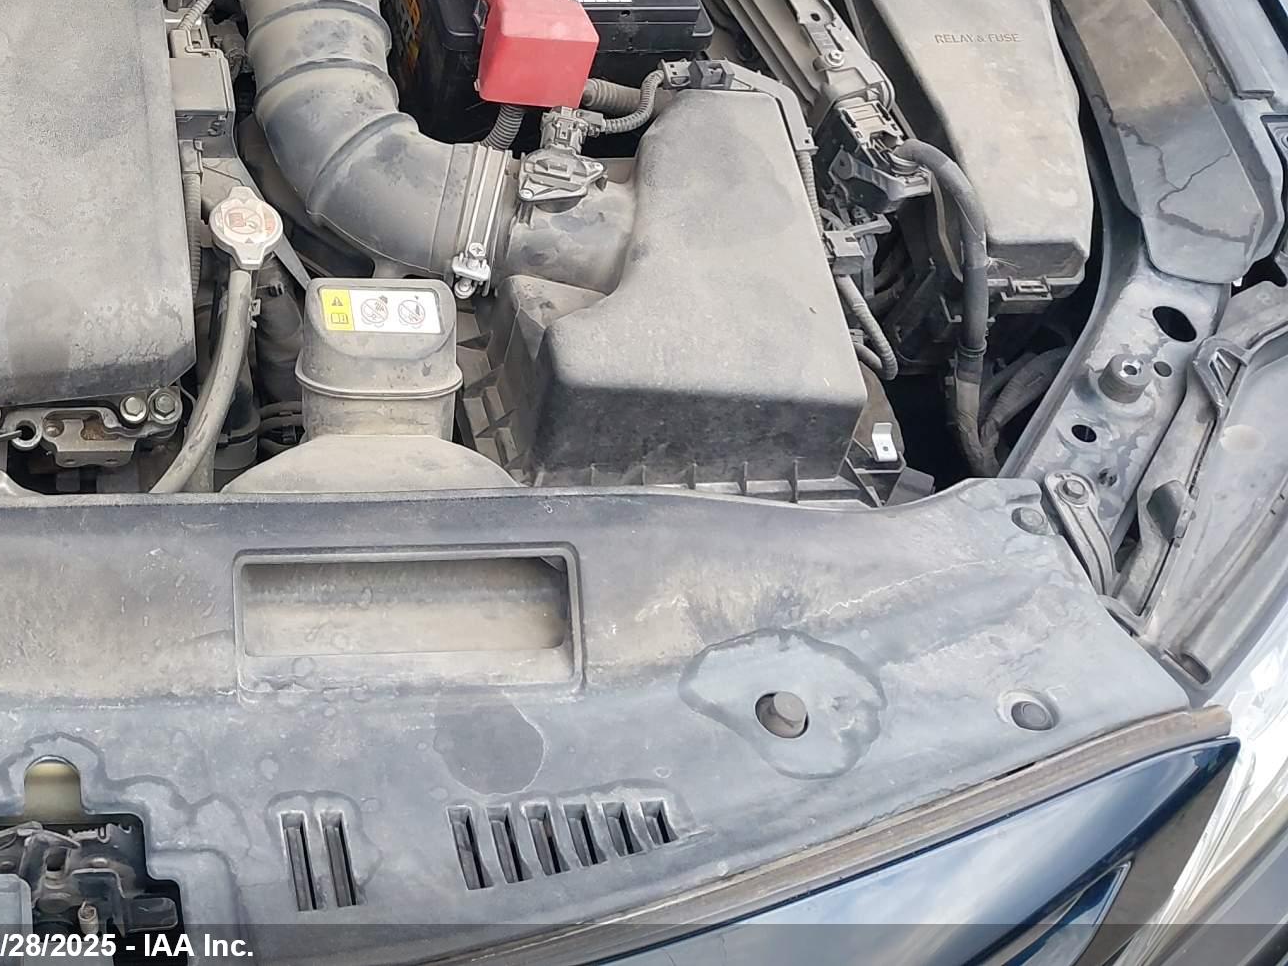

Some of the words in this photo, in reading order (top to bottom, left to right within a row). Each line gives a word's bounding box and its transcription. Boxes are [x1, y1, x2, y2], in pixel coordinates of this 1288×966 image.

[934, 34, 974, 44] RELAY
[977, 34, 987, 43] &
[989, 33, 1021, 43] FUSE
